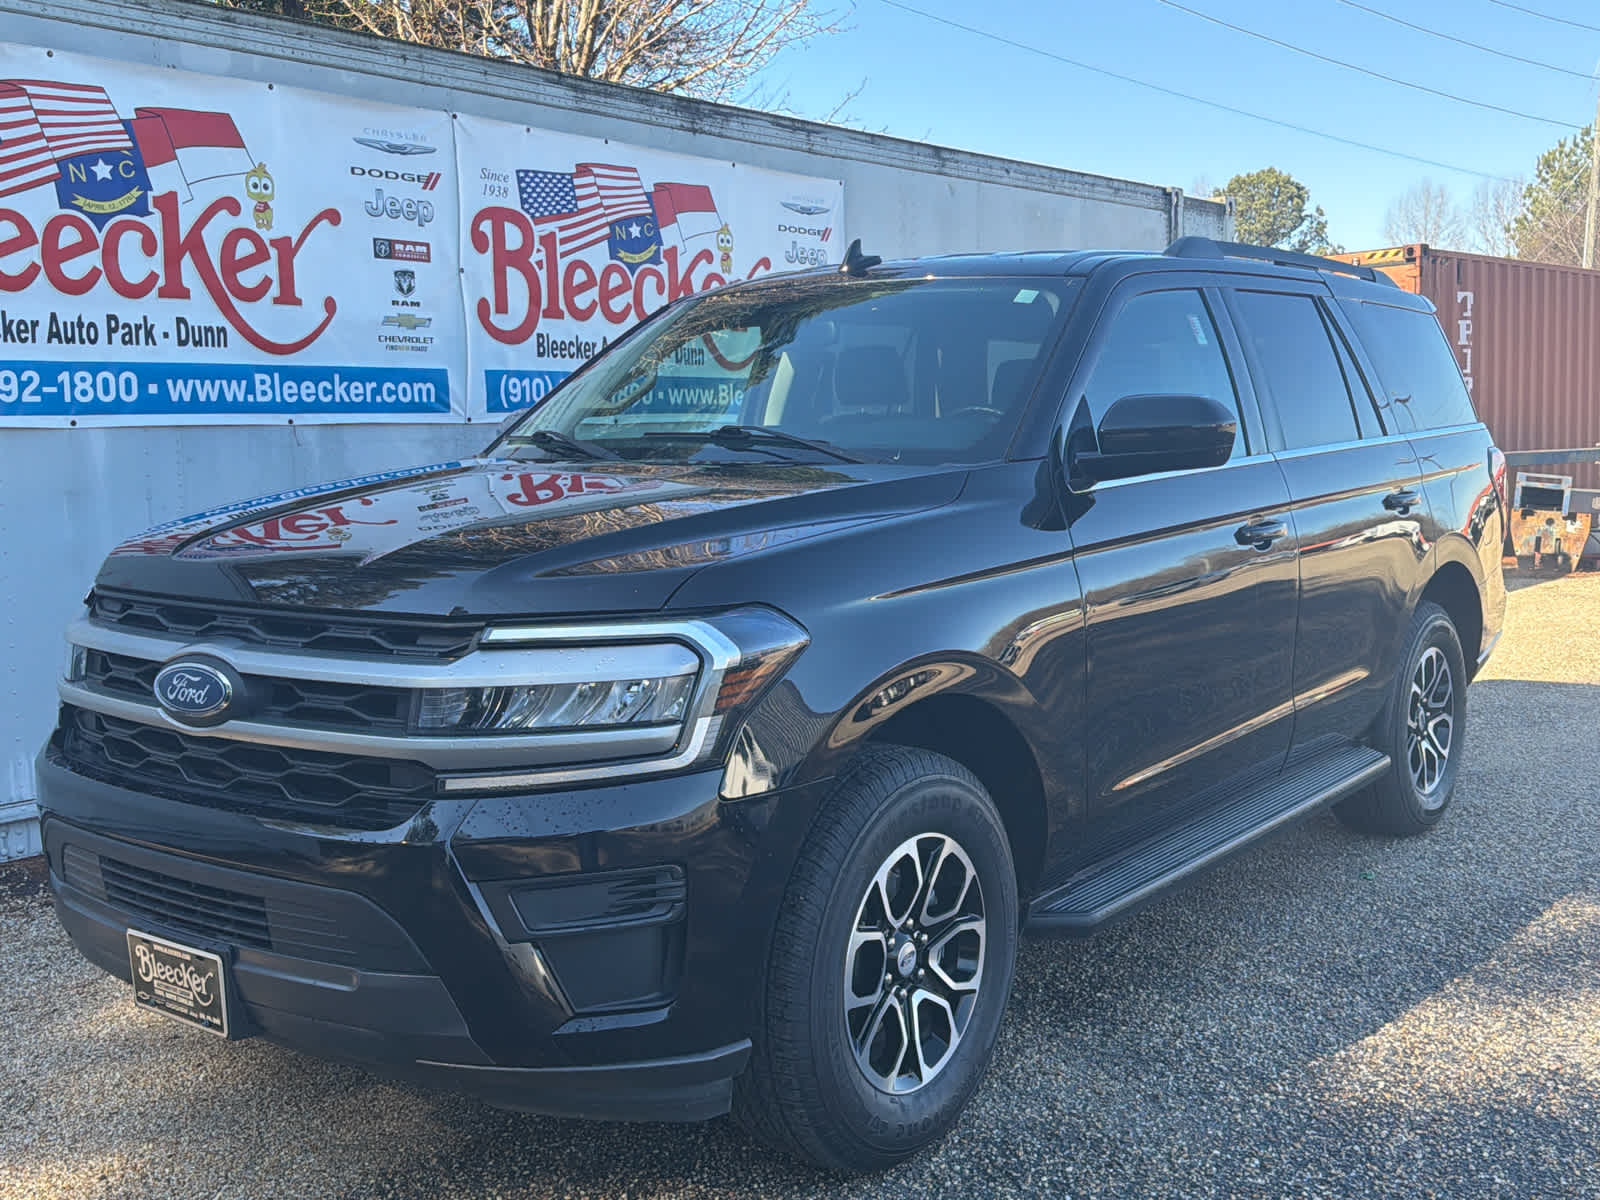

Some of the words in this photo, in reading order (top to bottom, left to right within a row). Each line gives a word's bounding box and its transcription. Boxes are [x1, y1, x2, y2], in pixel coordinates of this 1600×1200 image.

[350, 166, 430, 184] DODGE
[480, 167, 510, 183] Since
[483, 184, 509, 198] 1938
[365, 188, 434, 227] Jeep
[394, 243, 427, 253] RAM
[785, 240, 828, 266] Jeep
[471, 206, 771, 345] Bleeck
[0, 310, 39, 344] ker
[47, 312, 99, 345] Auto
[106, 313, 157, 347] Park
[176, 316, 228, 348] Dunn
[378, 335, 434, 344] CHEVROLET
[536, 333, 596, 359] Bleecker
[166, 371, 436, 404] www.Bleecker.com
[167, 672, 211, 705] Ford
[135, 944, 214, 1007] Bleecker
